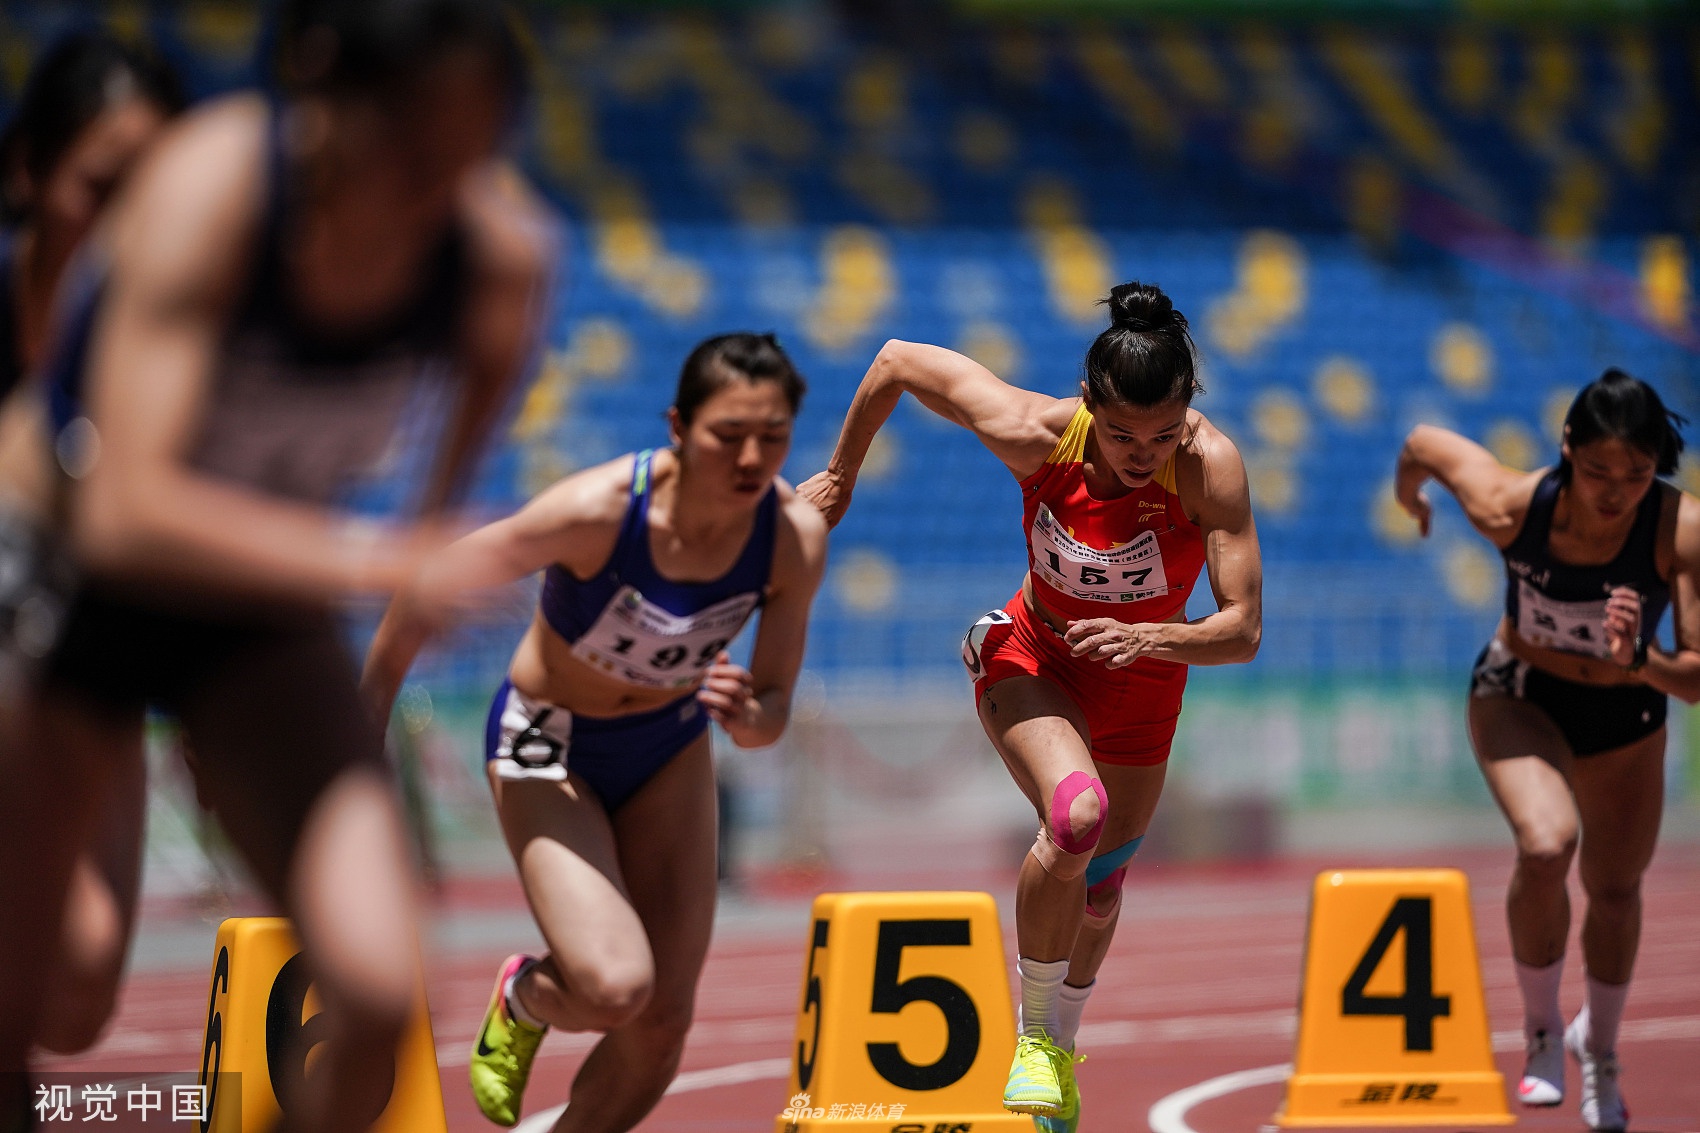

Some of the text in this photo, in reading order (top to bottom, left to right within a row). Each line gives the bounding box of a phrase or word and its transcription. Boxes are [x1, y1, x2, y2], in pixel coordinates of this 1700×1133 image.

[1044, 547, 1153, 586] 157
[512, 707, 563, 768] 6
[200, 945, 229, 1133] 6
[798, 919, 830, 1091] 5
[866, 919, 980, 1091] 5
[1341, 896, 1452, 1053] 4
